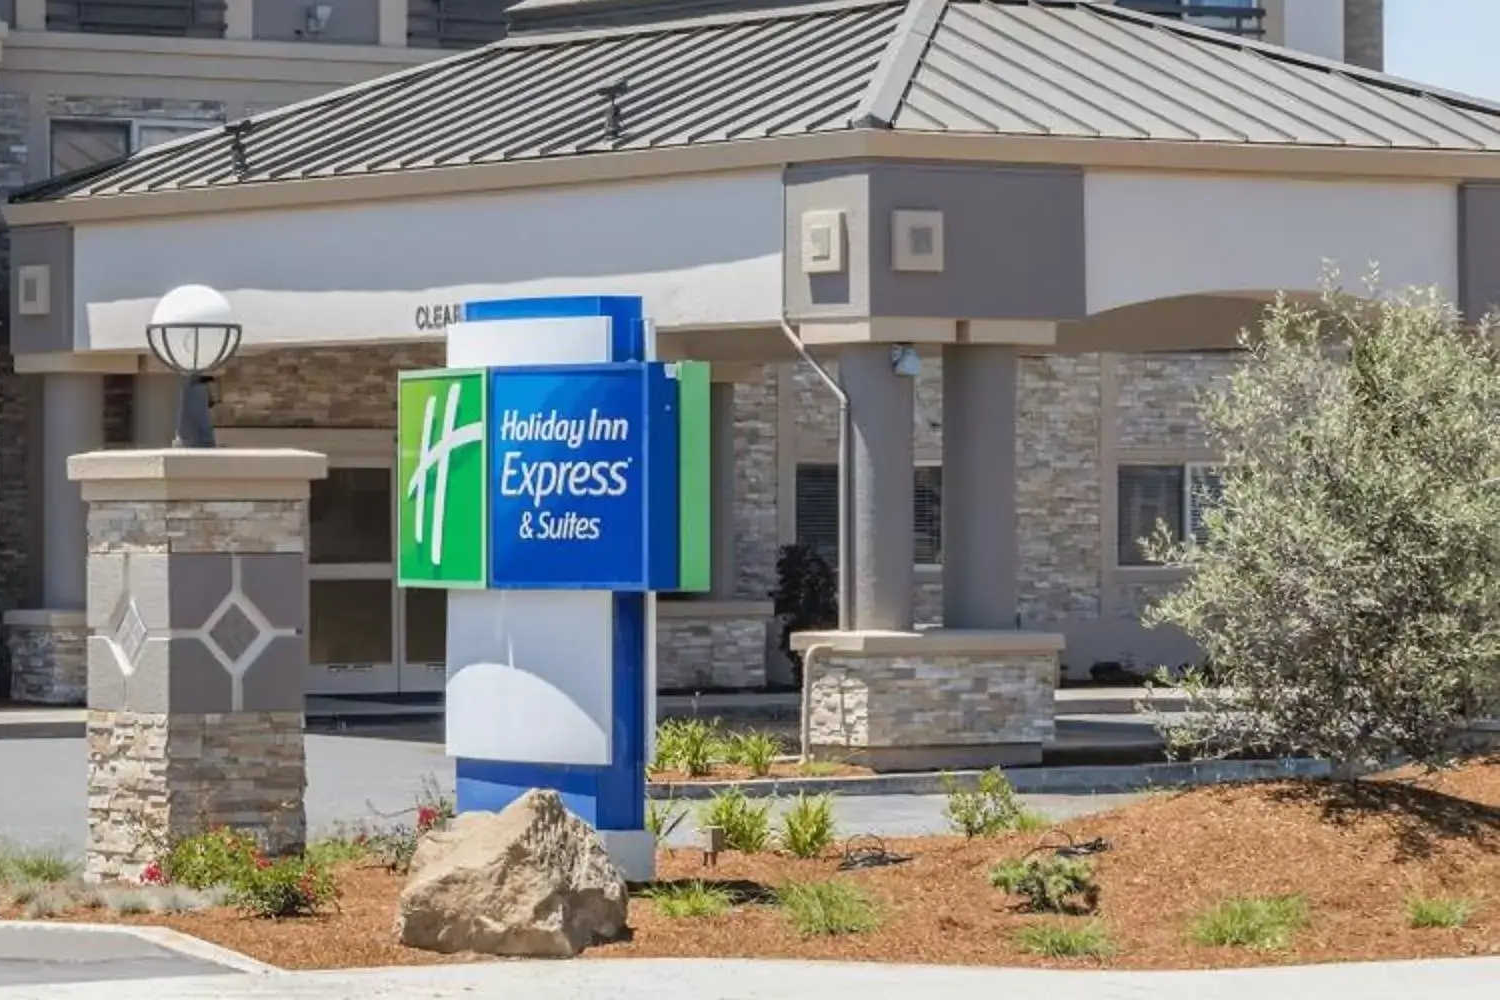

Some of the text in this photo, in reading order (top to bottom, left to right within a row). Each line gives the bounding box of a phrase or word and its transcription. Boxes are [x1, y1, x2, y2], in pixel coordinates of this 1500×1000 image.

[500, 408, 629, 449] Holiday Inn
[501, 451, 629, 508] Express
[519, 511, 601, 539] & Suites
